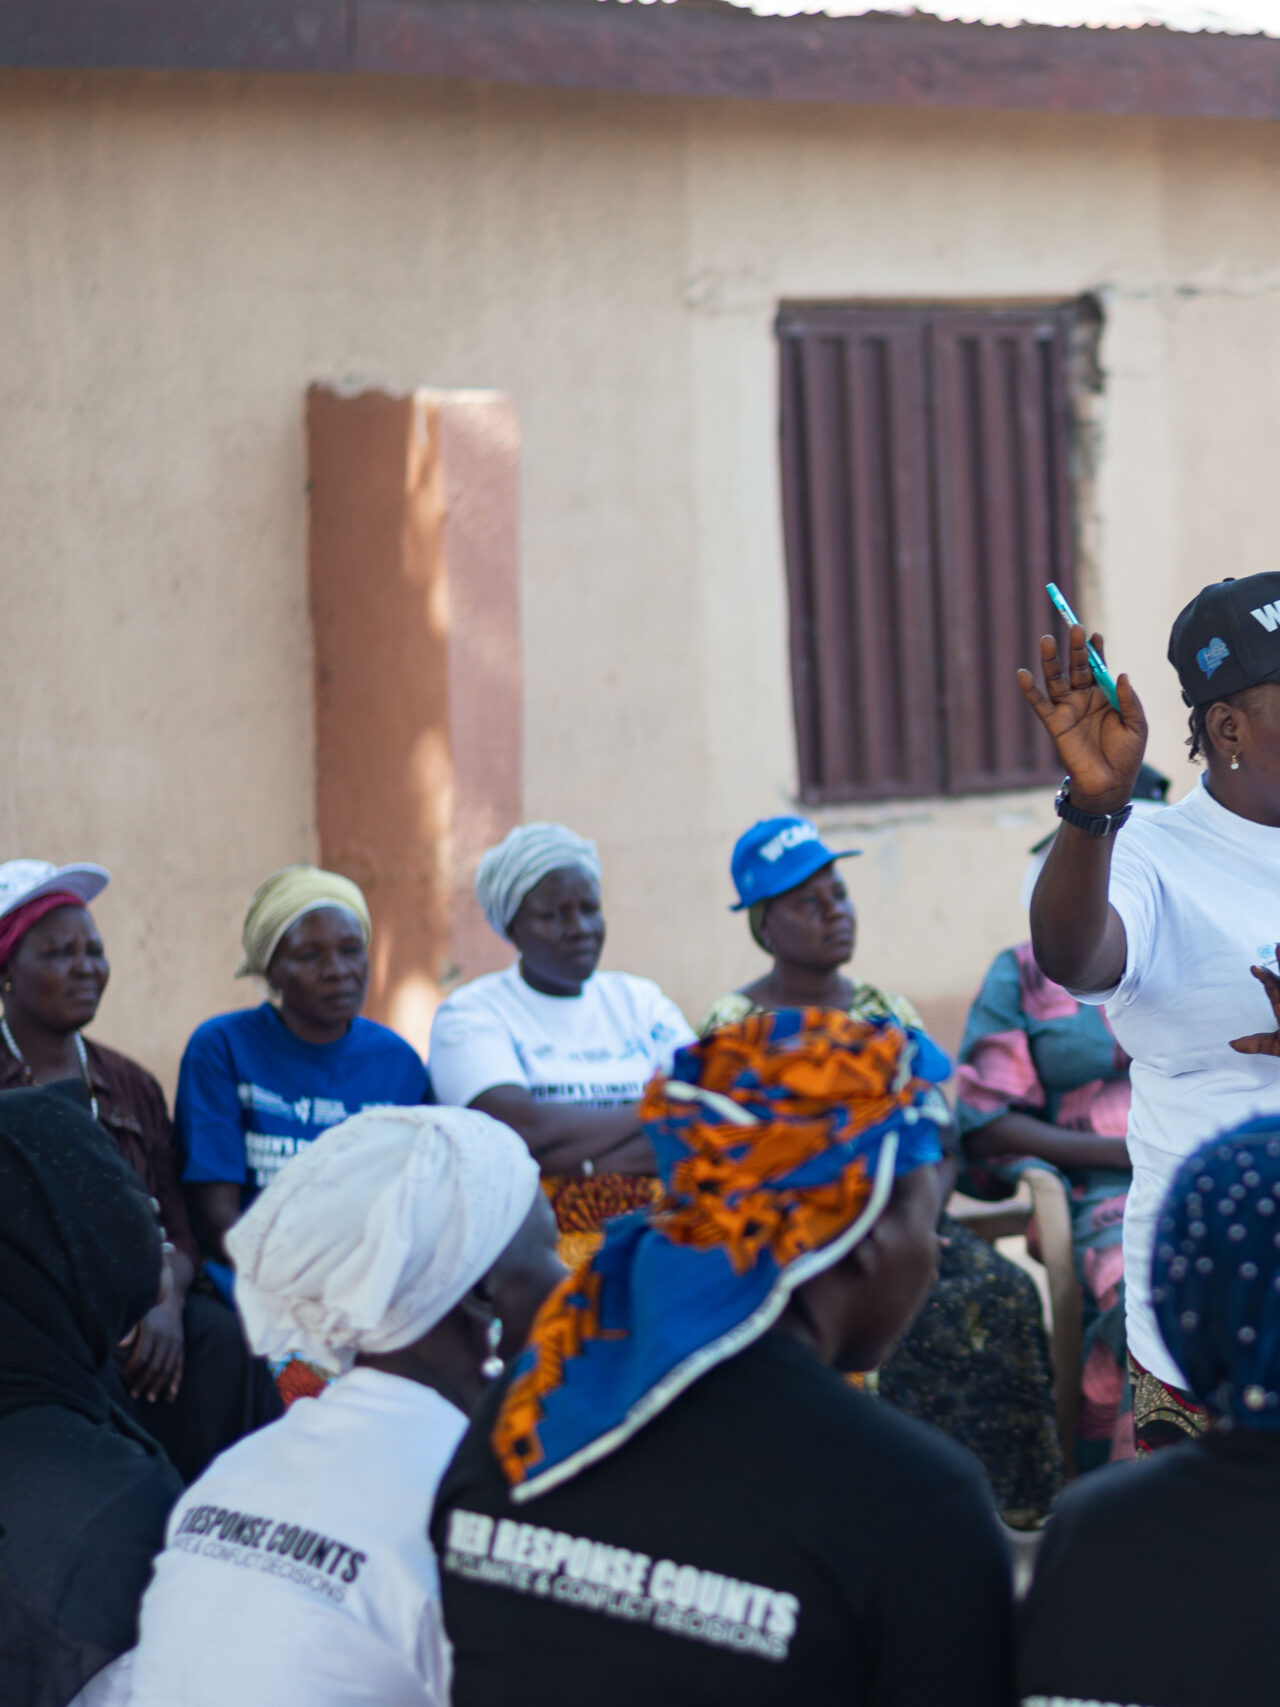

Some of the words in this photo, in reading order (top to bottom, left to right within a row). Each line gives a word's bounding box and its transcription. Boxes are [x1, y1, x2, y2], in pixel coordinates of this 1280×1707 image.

[260, 1552, 348, 1604] DECISIONS
[266, 1521, 368, 1584] COUNTS
[492, 1517, 652, 1597] RESPONSE
[649, 1558, 800, 1638] COUNTS
[533, 1571, 552, 1596] &
[552, 1573, 652, 1622] CONFLICT
[652, 1600, 789, 1662] DECISIONS
